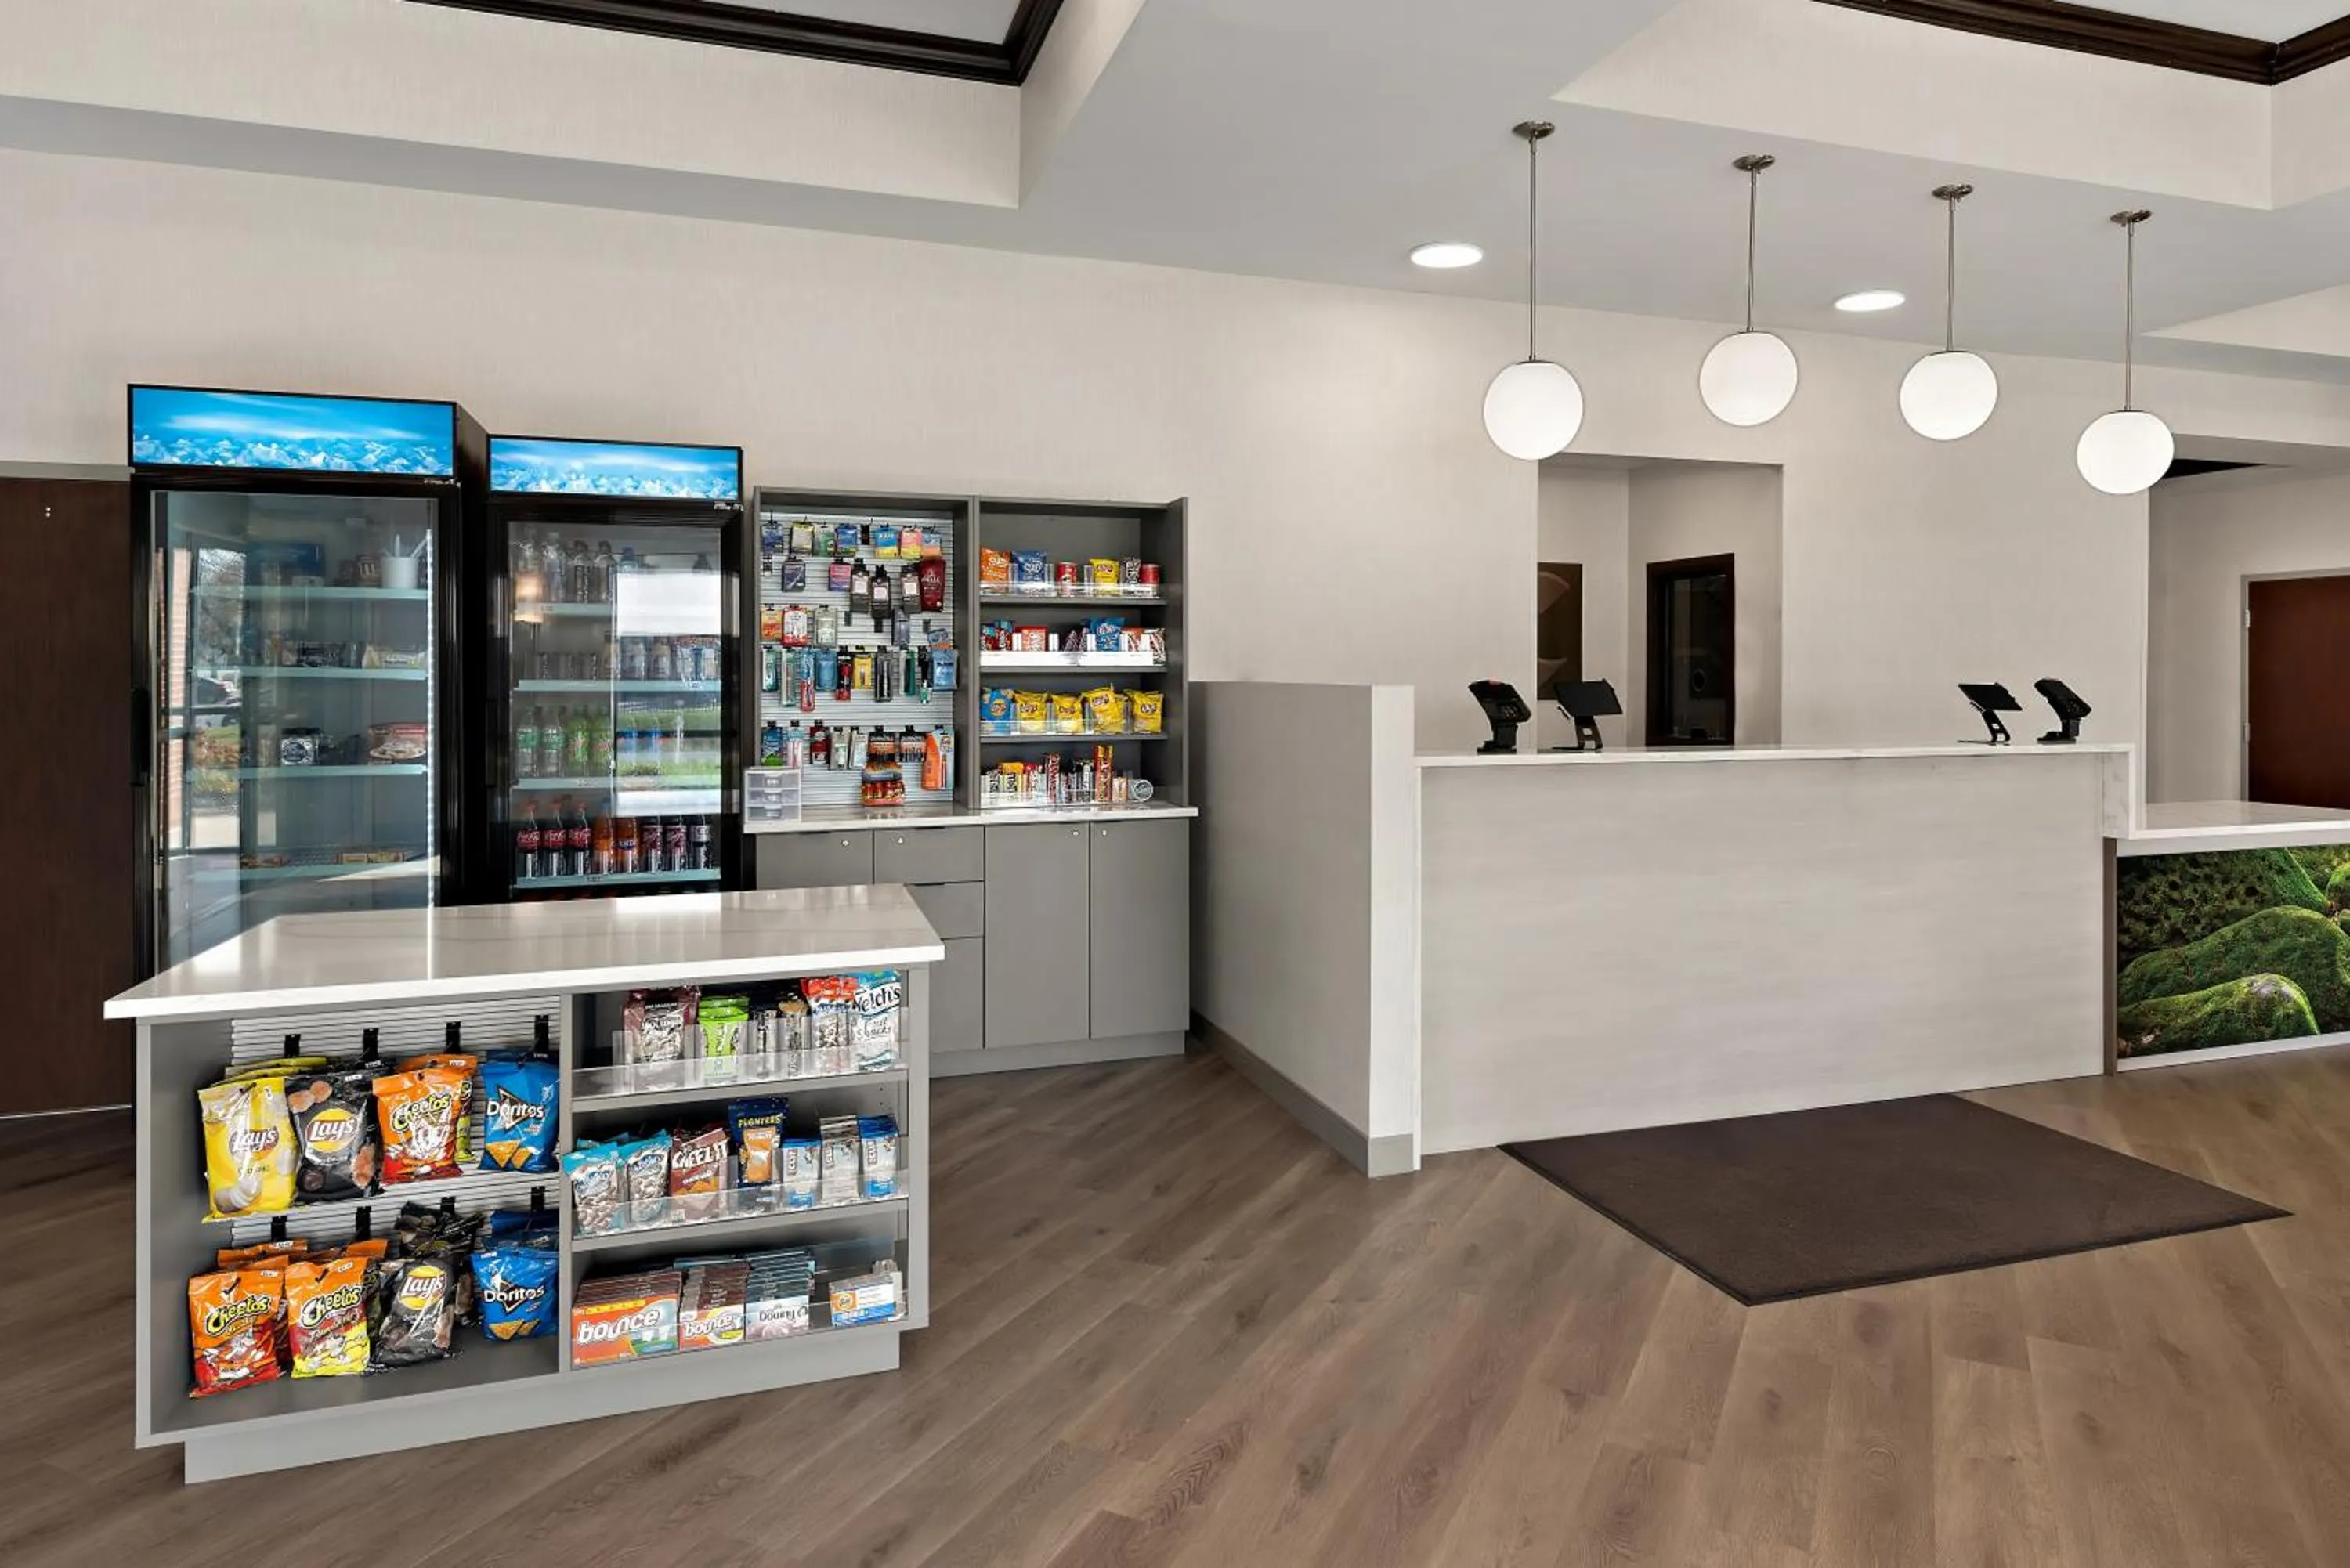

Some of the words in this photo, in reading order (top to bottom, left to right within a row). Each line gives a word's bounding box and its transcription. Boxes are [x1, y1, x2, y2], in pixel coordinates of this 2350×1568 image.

[486, 1100, 544, 1118] Doritos
[309, 1118, 355, 1142] Lay's
[400, 1274, 445, 1299] Lay's
[483, 1285, 545, 1302] Doritos
[206, 1295, 270, 1336] Cheetos
[301, 1286, 363, 1329] Cheetos
[577, 1310, 660, 1344] bounce
[685, 1315, 733, 1337] bounce
